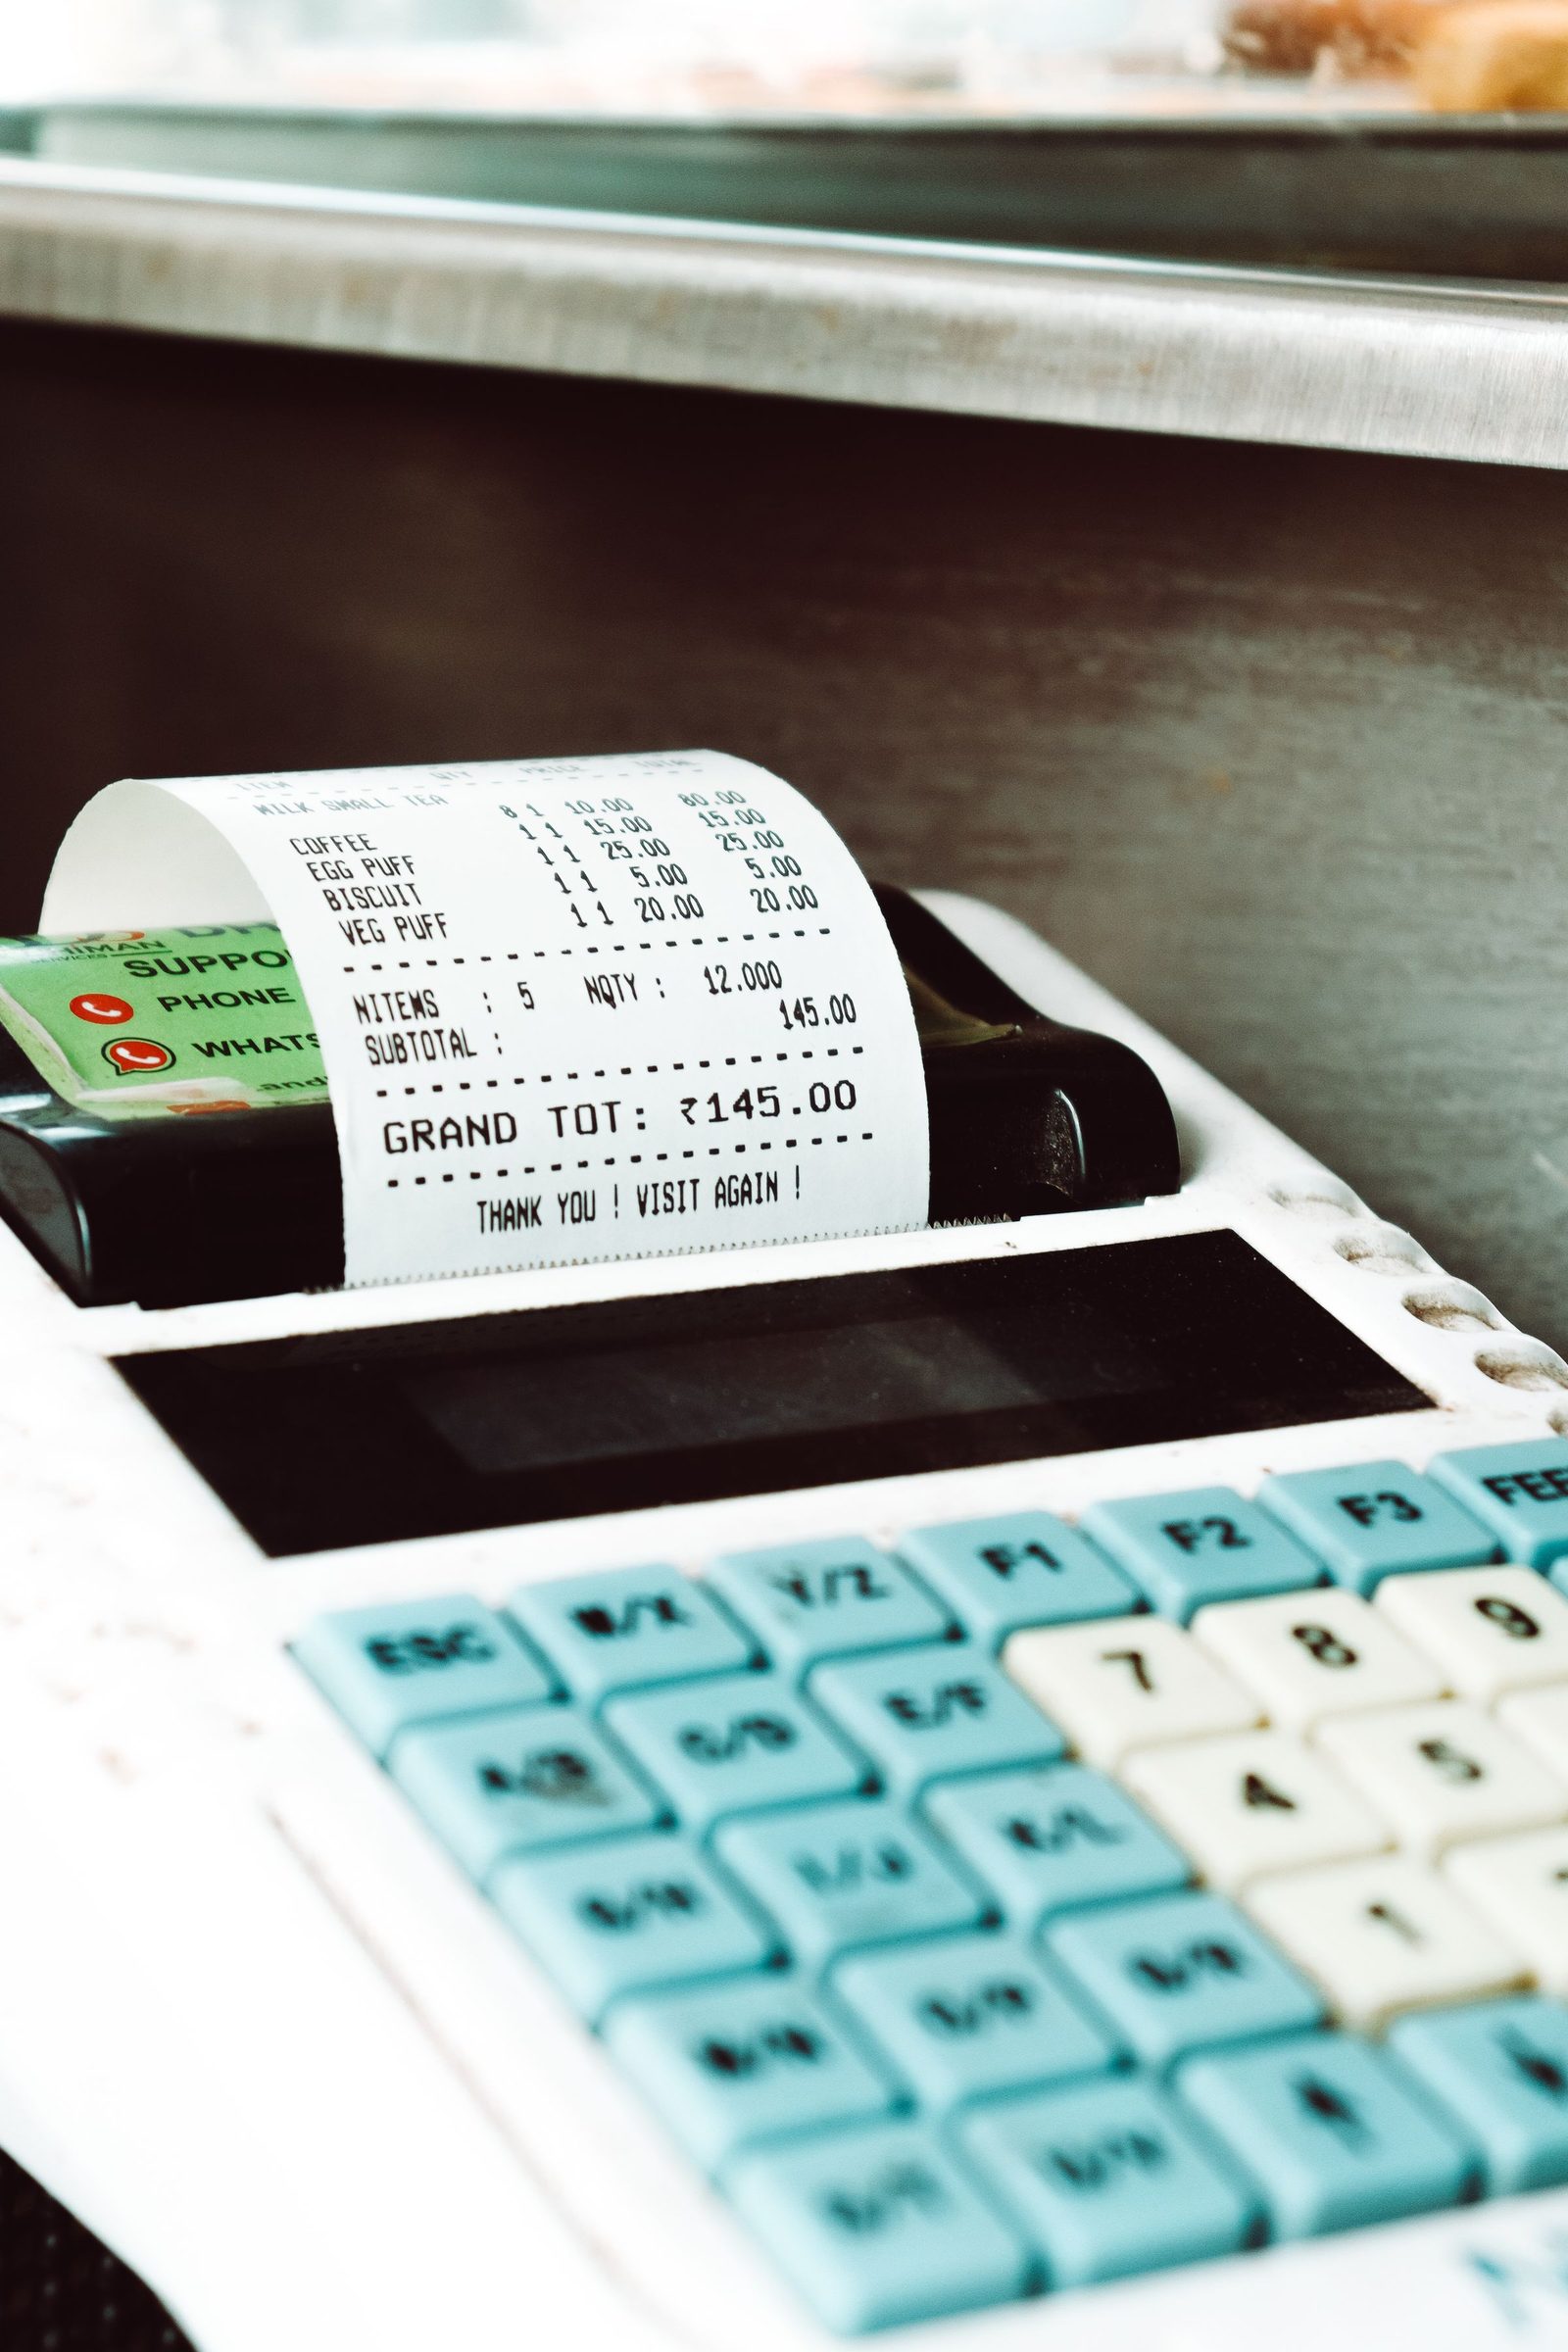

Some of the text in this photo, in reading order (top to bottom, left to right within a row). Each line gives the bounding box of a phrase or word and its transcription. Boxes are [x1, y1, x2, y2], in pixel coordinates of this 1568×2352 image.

[253, 793, 449, 816] MILK SMALL TEA
[500, 791, 746, 818] 8 1 10.00 80.00
[290, 808, 766, 856] COFFEE 1 1 15.00 15.00
[307, 830, 784, 882] EGG PUFF 1 1 25.00 25.00
[322, 856, 802, 911] BISCUIT 1 1 5.00 5.00
[339, 885, 818, 946] VEG PUFF 1 1 20.00 20.00
[123, 950, 292, 978] SUPPO
[157, 988, 296, 1012] PHONE
[353, 989, 439, 1024] NITEMS
[517, 982, 534, 1009] 5
[584, 973, 637, 1009] NQTY
[704, 960, 782, 995] 12.000
[366, 1028, 477, 1065] SUBTOTAL
[779, 994, 857, 1030] 145.00
[383, 1080, 857, 1154] GRAND TOT: ₹145.00
[477, 1165, 800, 1234] THANK YOU ! VISIT AGAIN !
[1336, 1492, 1424, 1528] F3
[1160, 1516, 1251, 1554] F2
[978, 1542, 1061, 1580] F1
[1474, 1597, 1542, 1640] 9
[364, 1624, 498, 1674] ESC
[1291, 1625, 1358, 1668] 8
[1103, 1650, 1153, 1692] 7
[1242, 1773, 1296, 1812] 4
